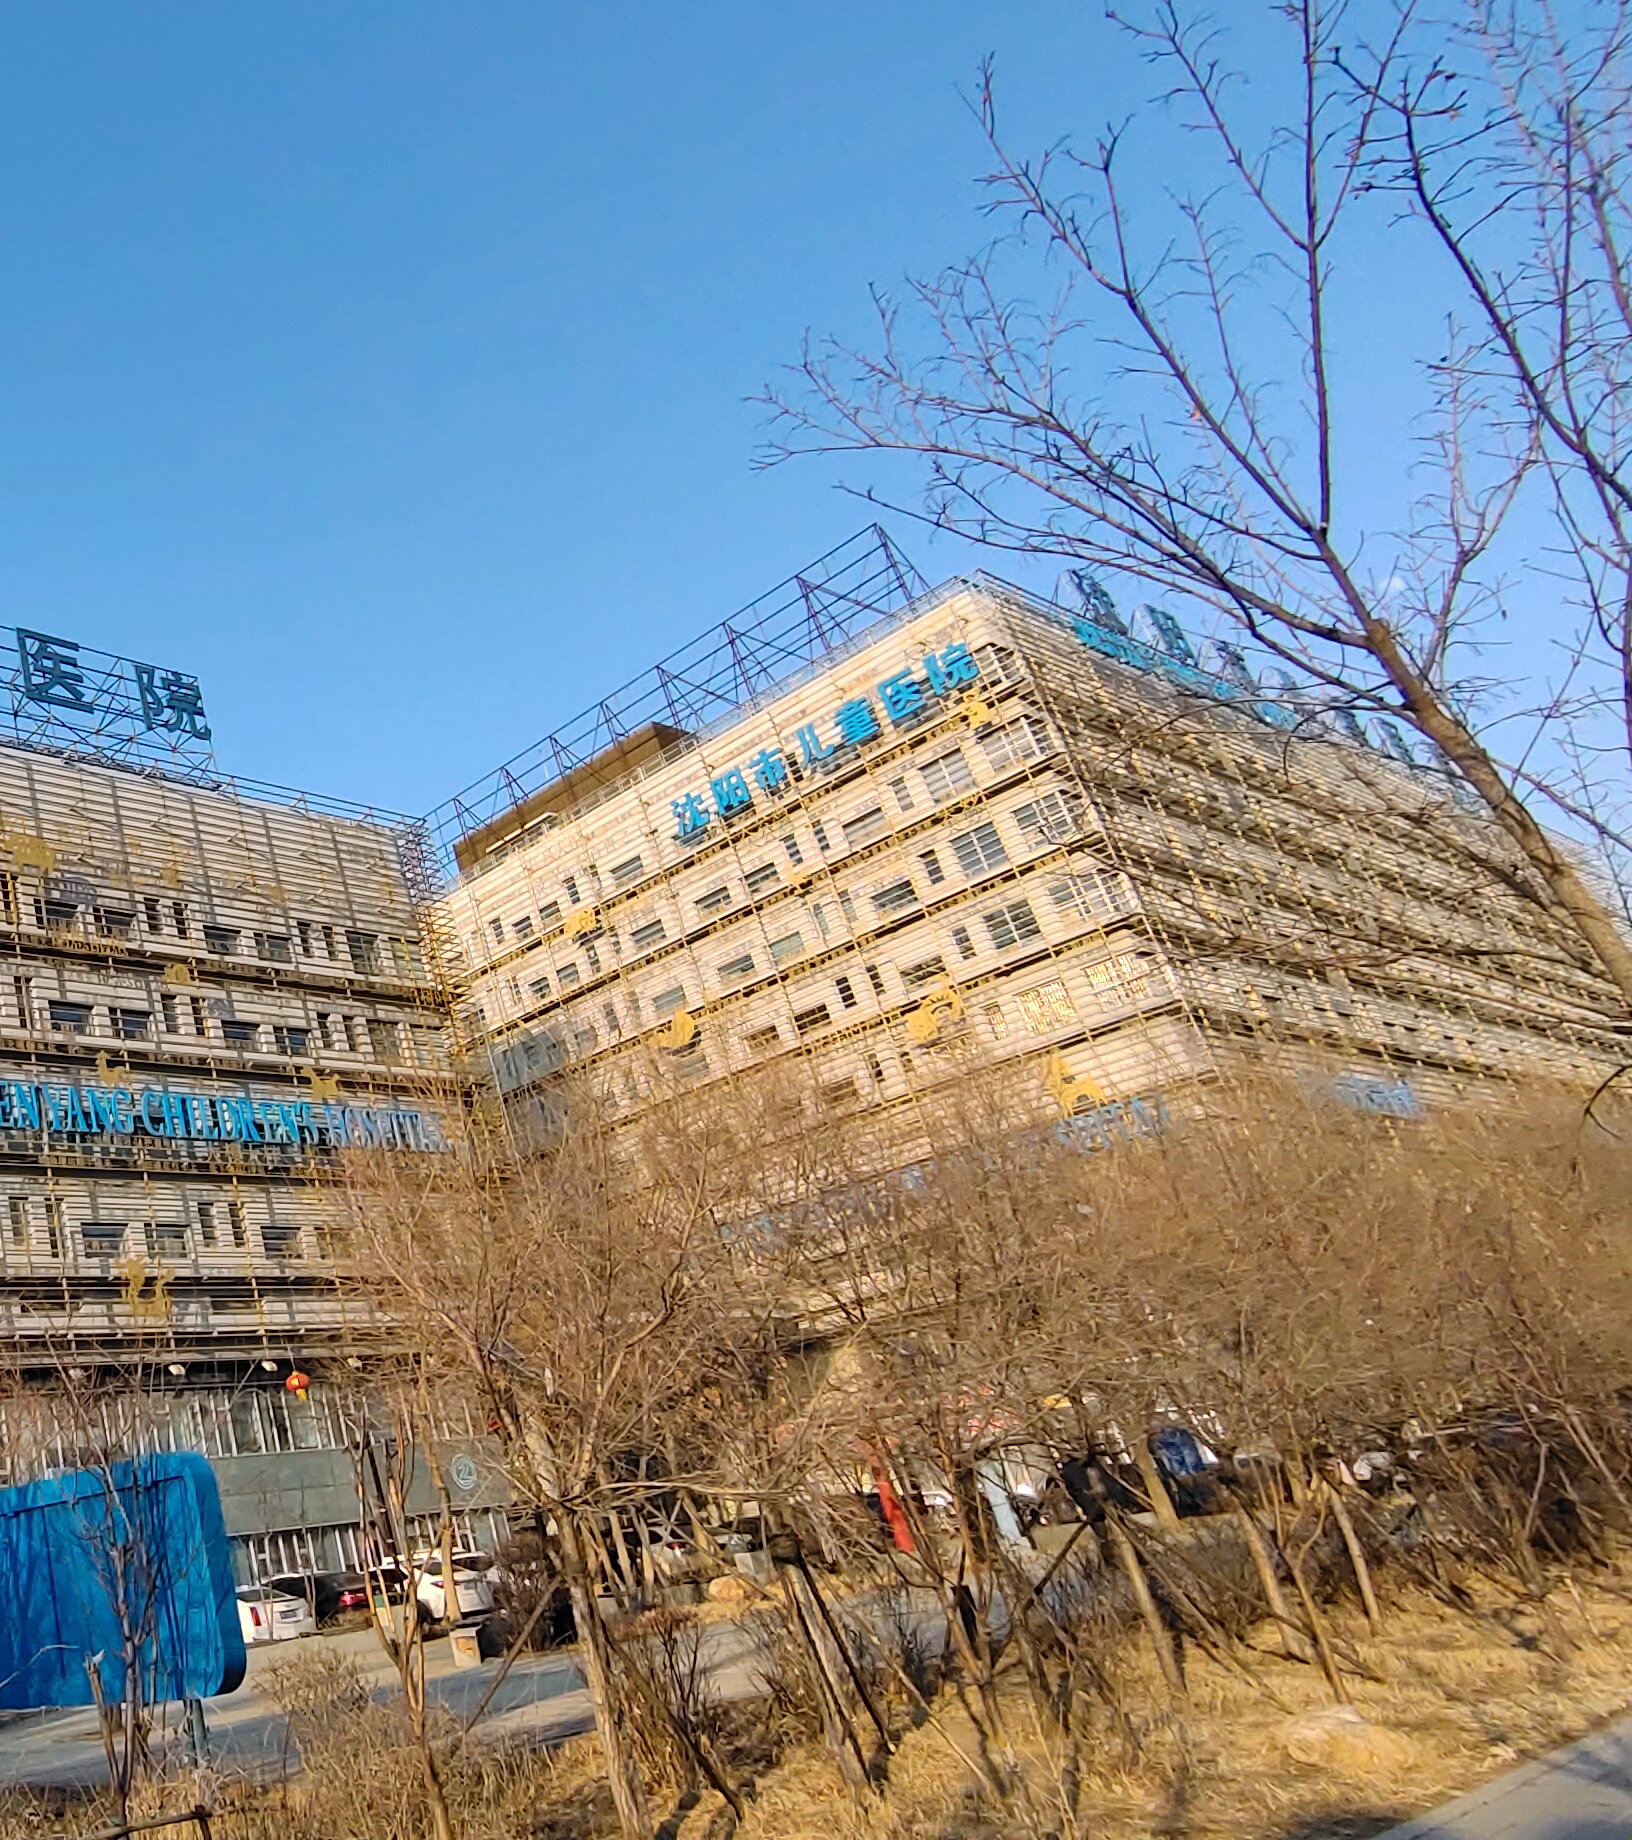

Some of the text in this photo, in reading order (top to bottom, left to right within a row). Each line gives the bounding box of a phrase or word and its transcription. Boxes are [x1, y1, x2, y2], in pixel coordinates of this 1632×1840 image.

[670, 641, 979, 836] 沈阳市儿童医院
[141, 1089, 319, 1147] CHILDREN'S
